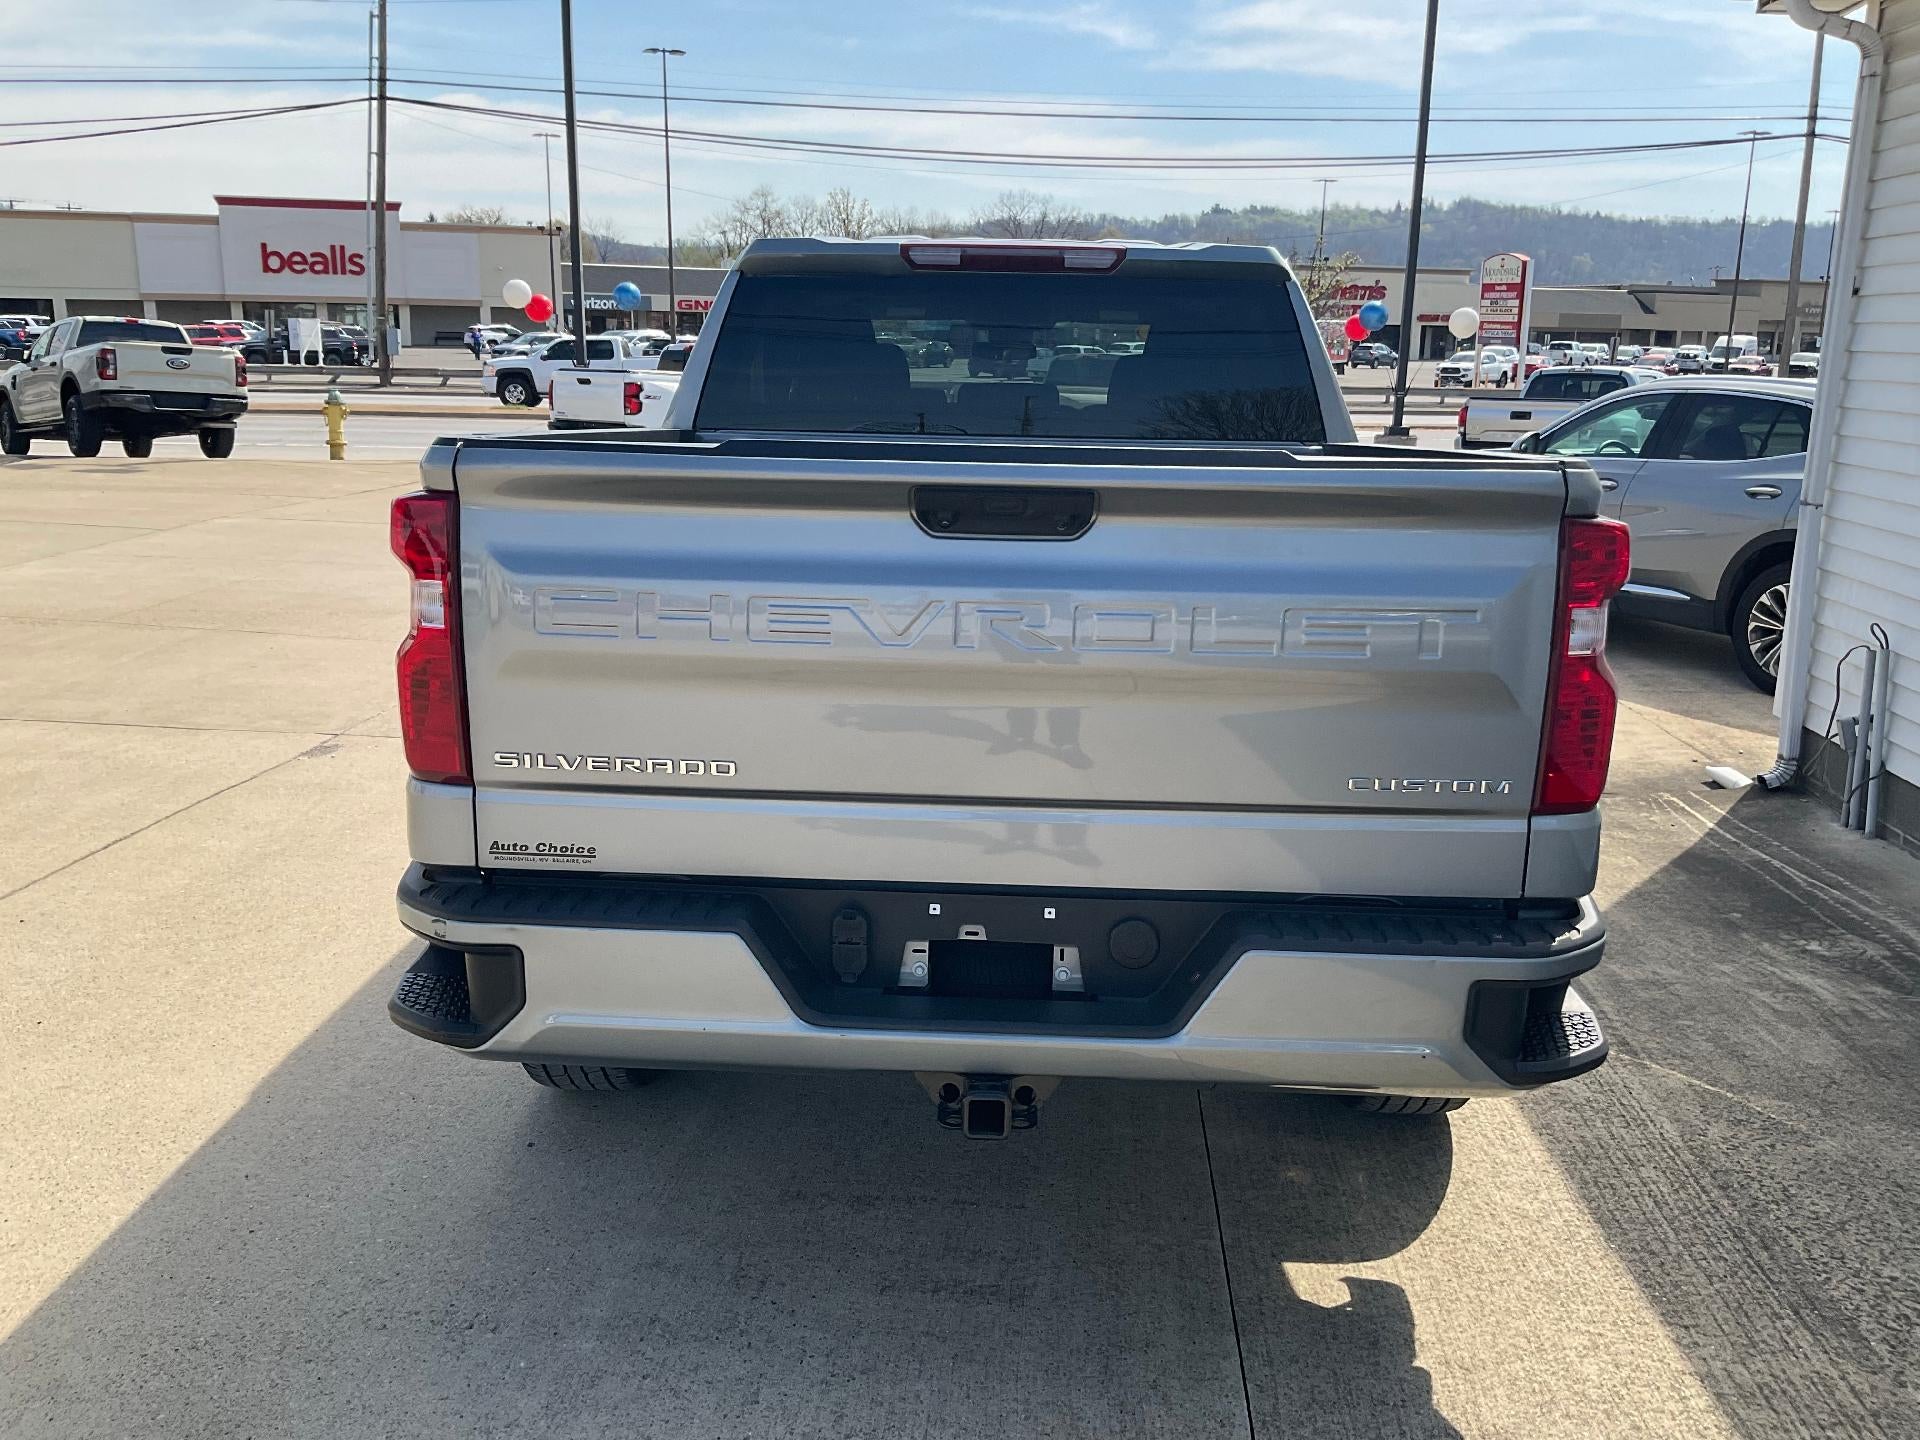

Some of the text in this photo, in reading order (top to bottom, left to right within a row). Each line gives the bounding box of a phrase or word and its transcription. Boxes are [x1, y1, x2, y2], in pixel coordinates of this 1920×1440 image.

[260, 242, 365, 276] bealls
[570, 297, 617, 310] rizon
[533, 587, 1482, 660] CHEVROLET
[493, 751, 738, 777] SILVERADO
[1347, 777, 1513, 794] CUSTOM
[489, 840, 597, 854] Auto Choice
